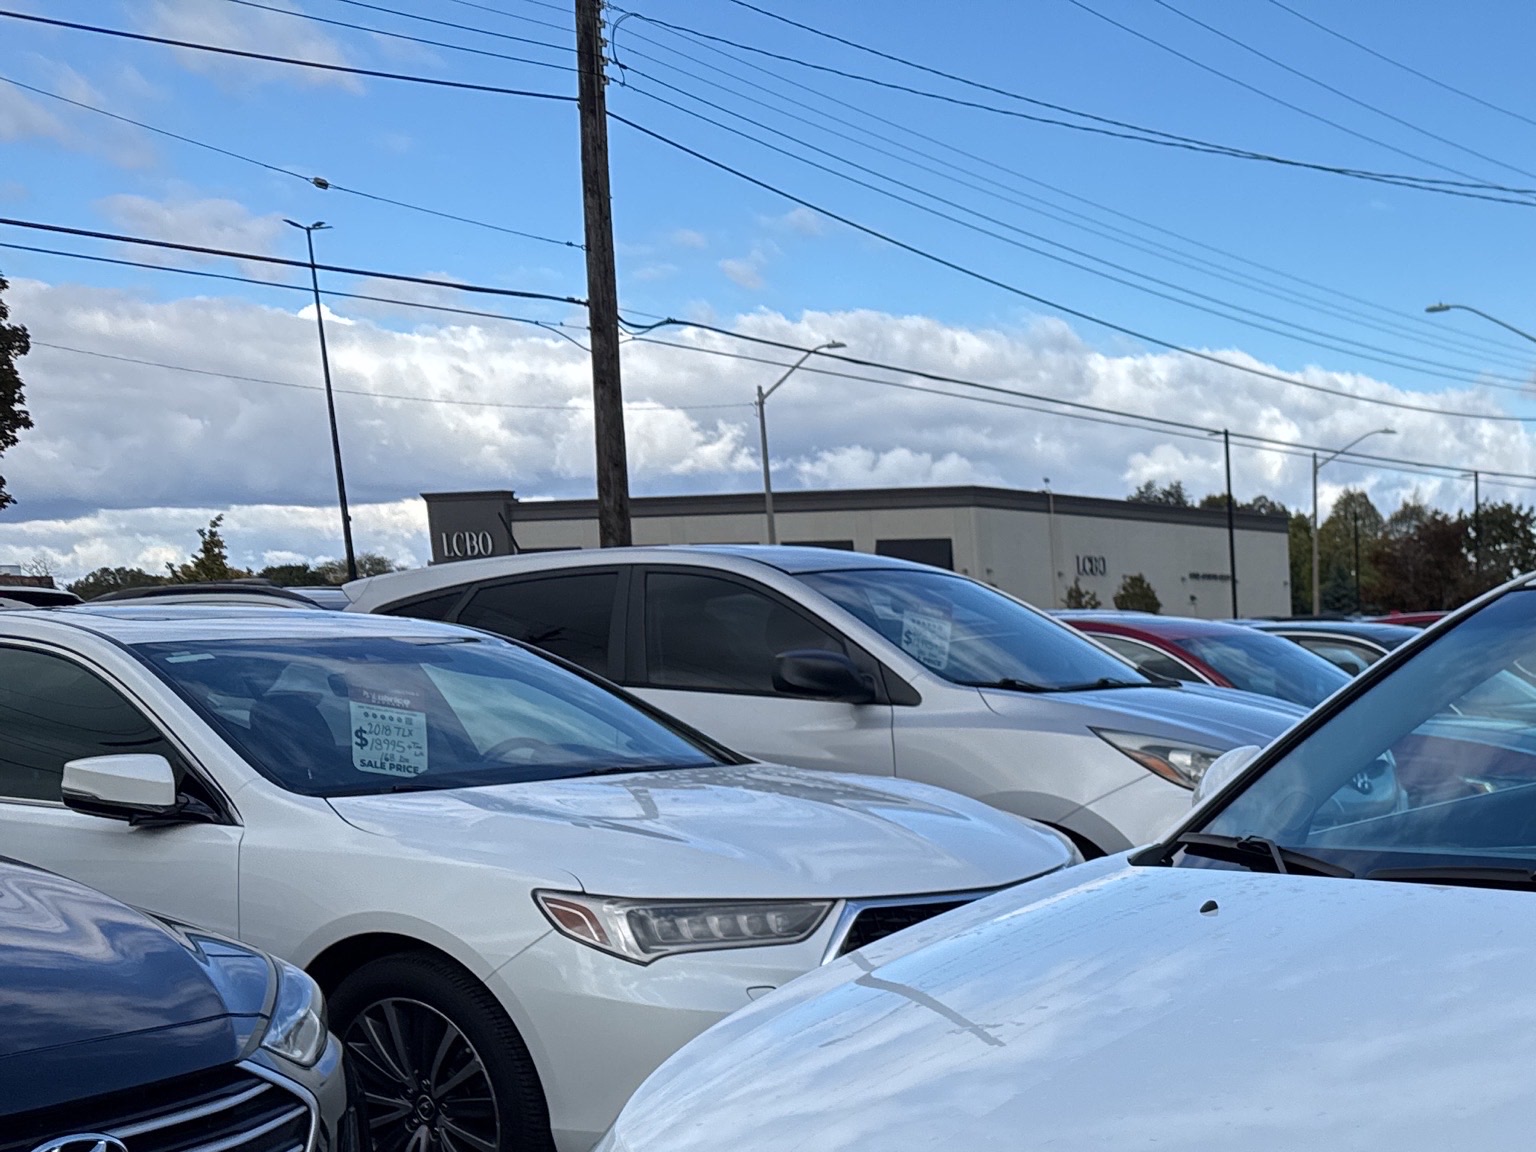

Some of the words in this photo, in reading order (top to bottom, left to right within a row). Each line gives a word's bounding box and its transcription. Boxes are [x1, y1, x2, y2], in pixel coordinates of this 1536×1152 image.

[442, 531, 493, 557] LCBO
[367, 722, 392, 737] 2018
[394, 726, 413, 737] TLX
[360, 759, 387, 770] SALE
[388, 762, 420, 774] PRICE
